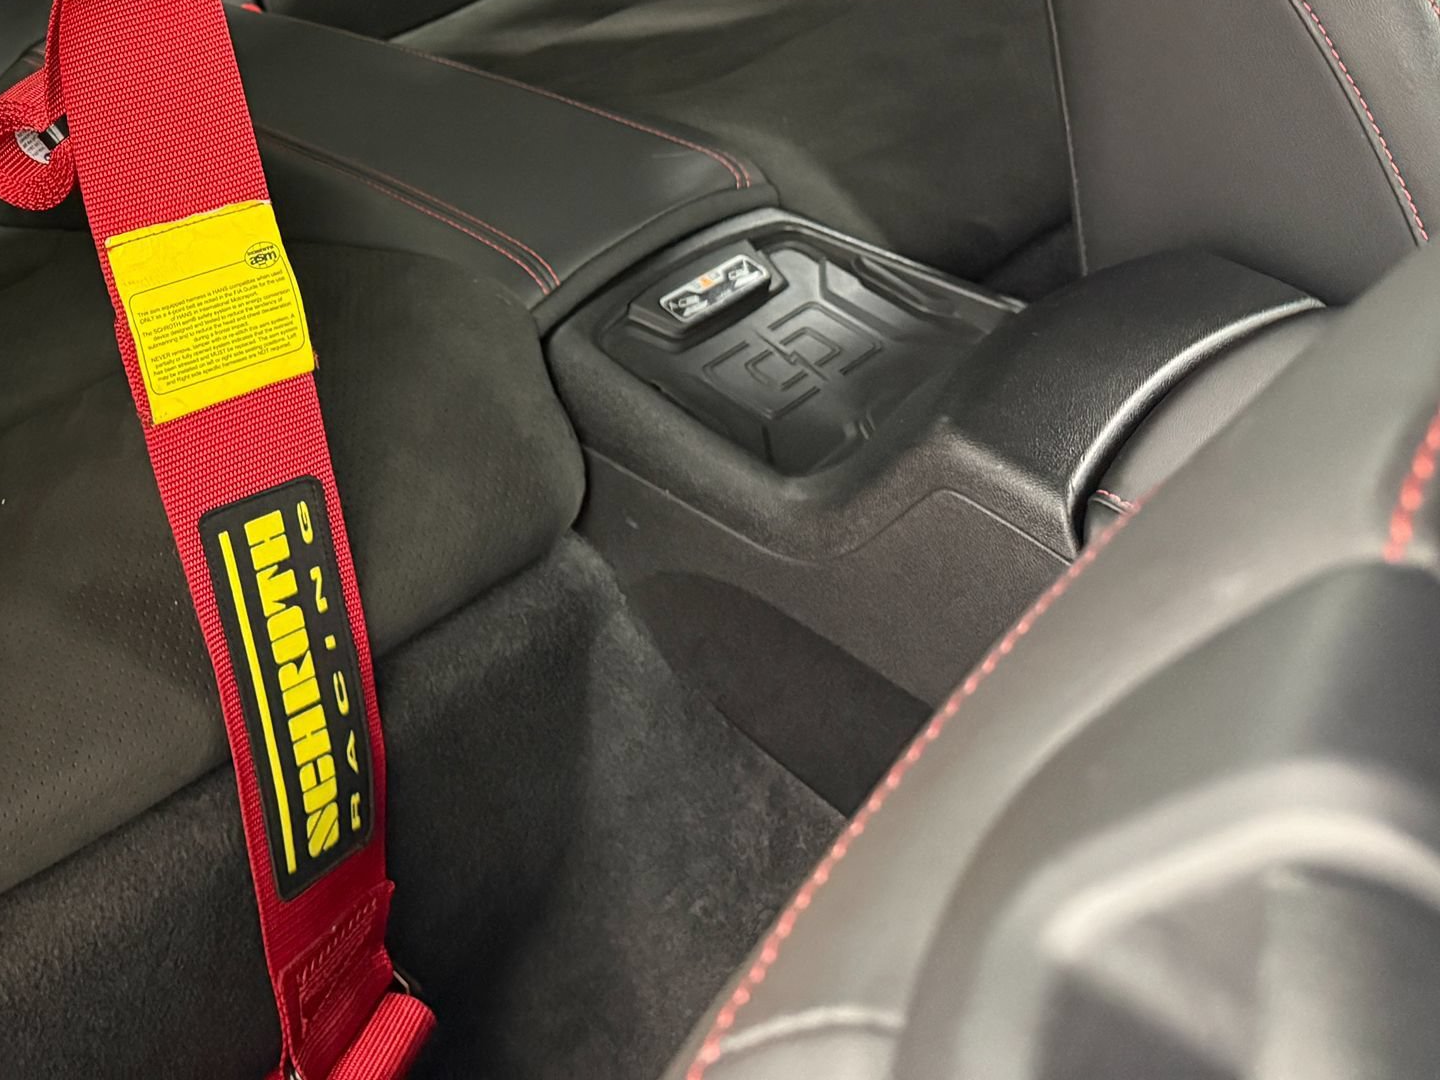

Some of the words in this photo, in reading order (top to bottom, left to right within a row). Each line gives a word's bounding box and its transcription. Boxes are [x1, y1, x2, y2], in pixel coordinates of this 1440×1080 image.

[250, 251, 277, 265] asm
[212, 285, 228, 294] HANS
[139, 315, 154, 324] ONLY
[176, 311, 192, 319] HANS
[153, 321, 181, 333] SCHROTH
[150, 352, 170, 362] NEVER
[210, 348, 226, 357] MUST
[298, 502, 362, 831] RACING
[243, 509, 340, 858] SCHROTH
